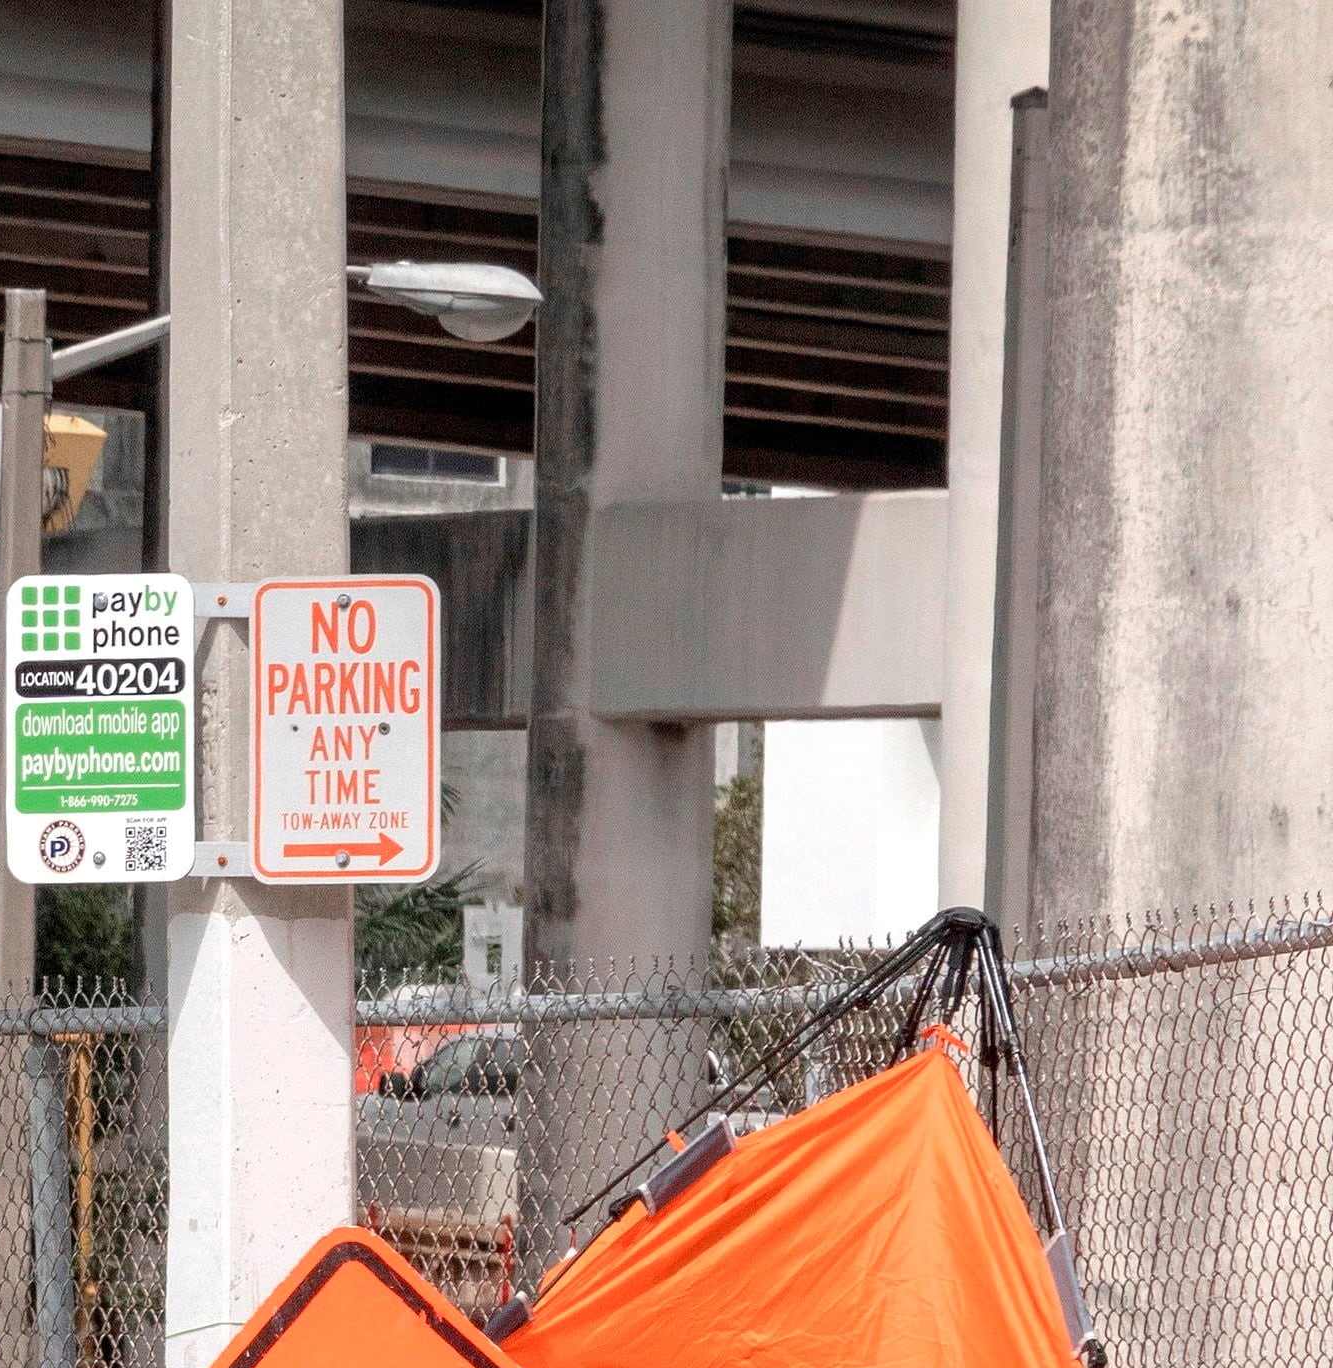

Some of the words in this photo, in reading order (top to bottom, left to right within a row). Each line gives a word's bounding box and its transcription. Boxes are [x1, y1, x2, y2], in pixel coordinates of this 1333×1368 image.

[92, 584, 178, 618] payby
[93, 620, 180, 653] phone
[312, 599, 376, 655] NO
[20, 671, 74, 688] LOCATION
[75, 661, 179, 696] 40204
[268, 659, 421, 716] PARKING
[22, 707, 94, 737] download
[98, 706, 148, 734] mobile
[151, 711, 181, 740] app
[309, 725, 377, 762] ANY
[21, 746, 181, 782] paybyphone.com
[305, 769, 381, 805] TIME
[282, 811, 361, 831] TOW-AWAY
[369, 811, 410, 830] ZONE
